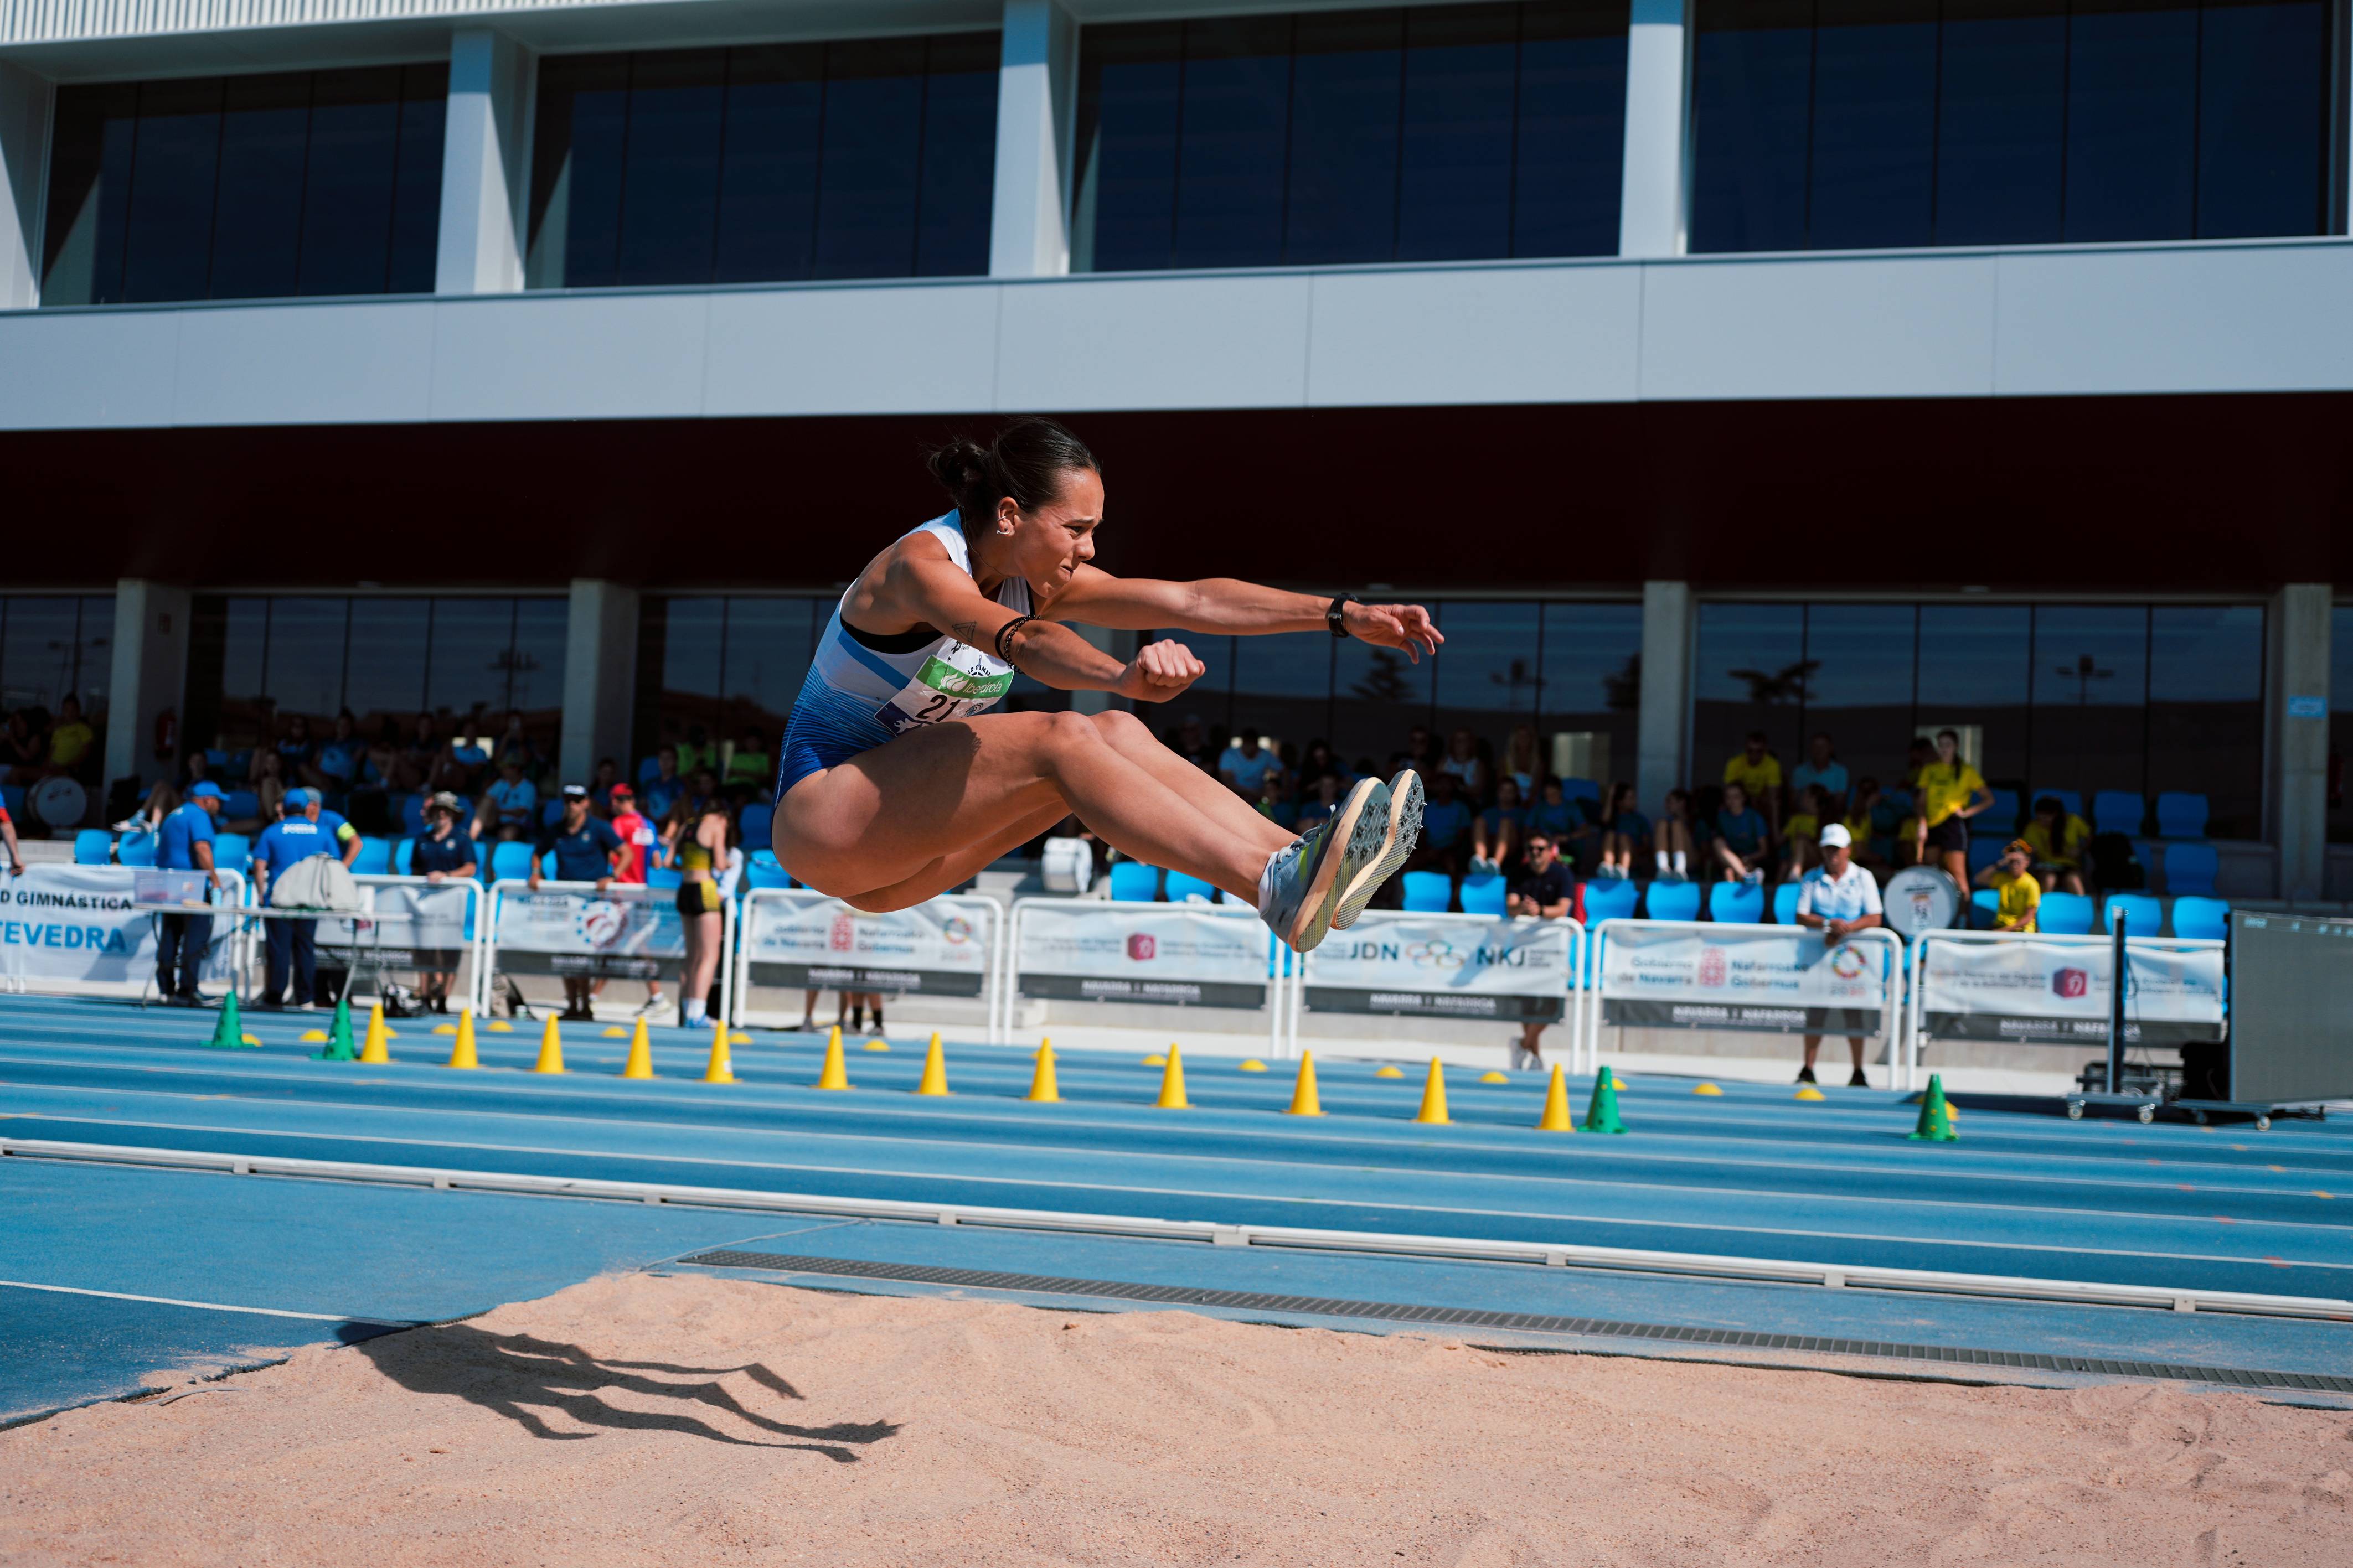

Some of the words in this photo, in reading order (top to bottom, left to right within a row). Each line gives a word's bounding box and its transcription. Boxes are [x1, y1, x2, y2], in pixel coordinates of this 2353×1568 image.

[915, 694, 961, 722] 21
[17, 890, 132, 909] GIMNÁSTICA
[0, 921, 126, 953] EVEDRA
[1350, 942, 1399, 961] JDN
[1477, 946, 1525, 966] NKJ
